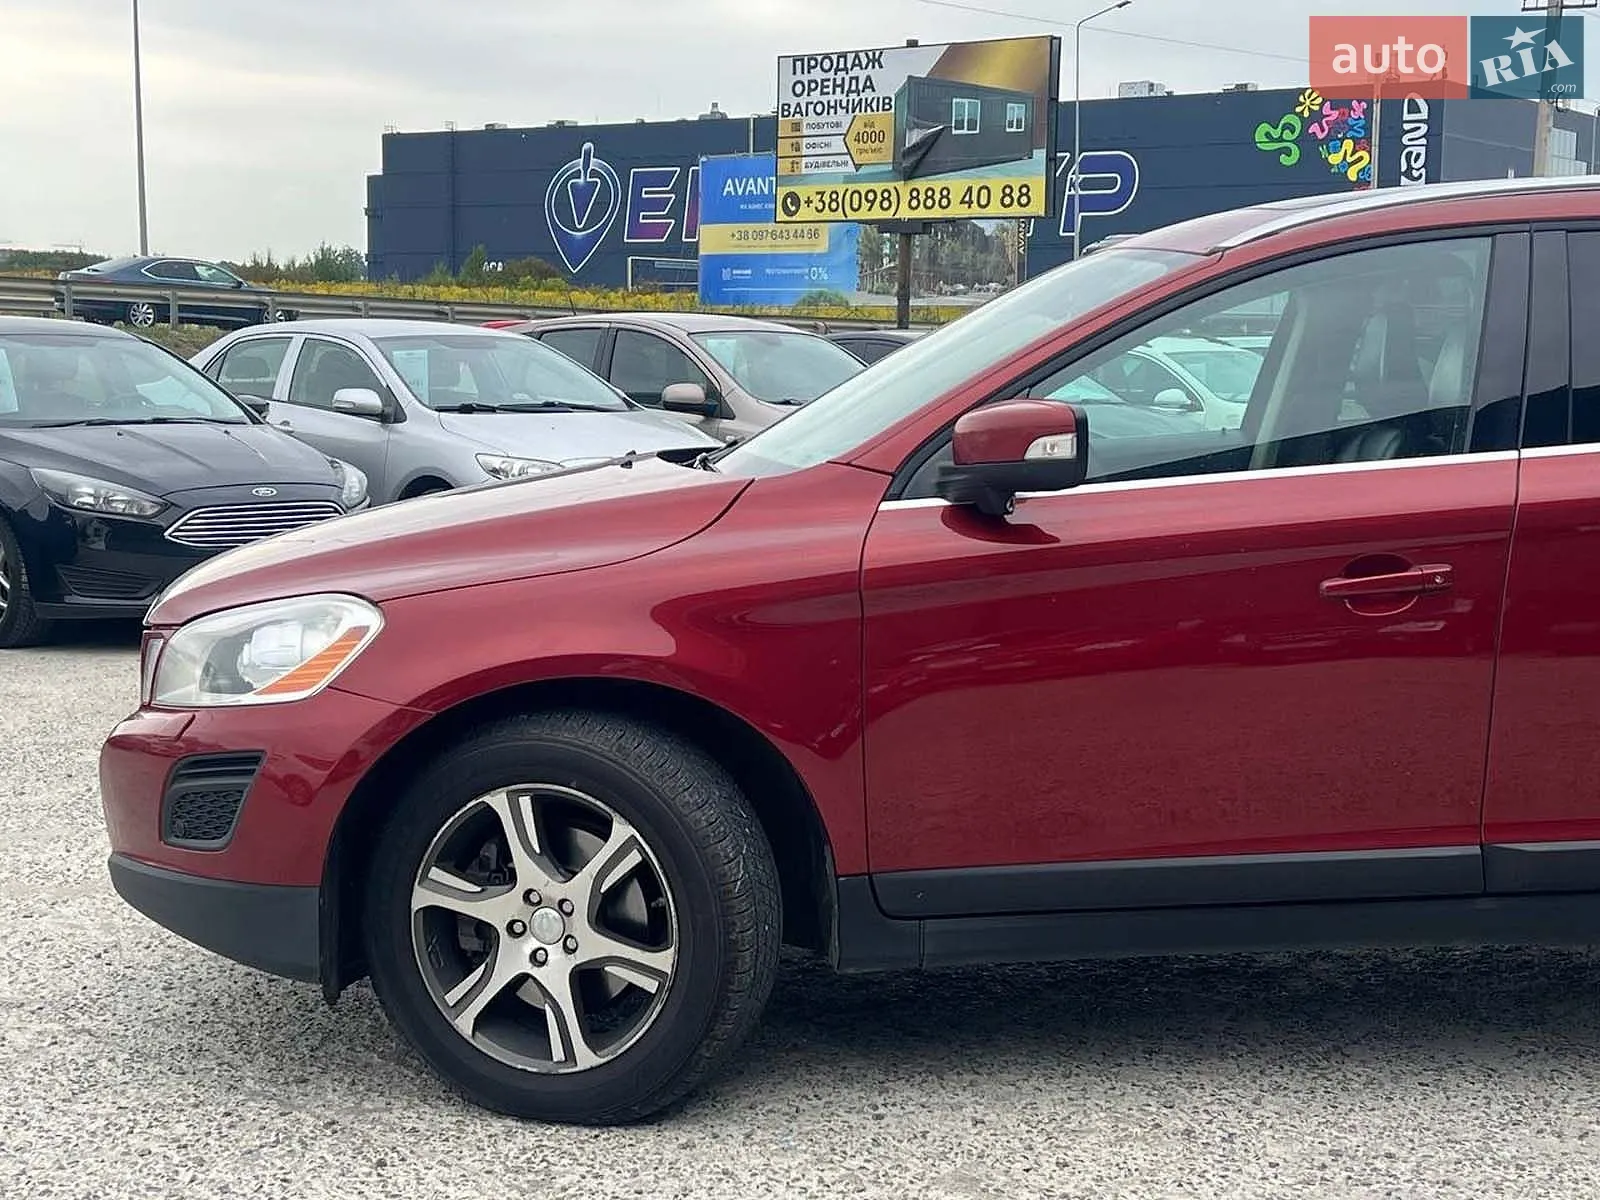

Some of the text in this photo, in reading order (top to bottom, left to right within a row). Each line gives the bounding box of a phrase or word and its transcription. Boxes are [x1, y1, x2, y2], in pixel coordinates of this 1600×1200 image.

[791, 51, 884, 76] ПРОДАЖ
[791, 75, 876, 98] ОРЕНДА
[780, 96, 893, 118] ВАГОНЧИКІВ
[853, 130, 886, 144] 4000
[803, 184, 1031, 218] +38(098) 888 40 88
